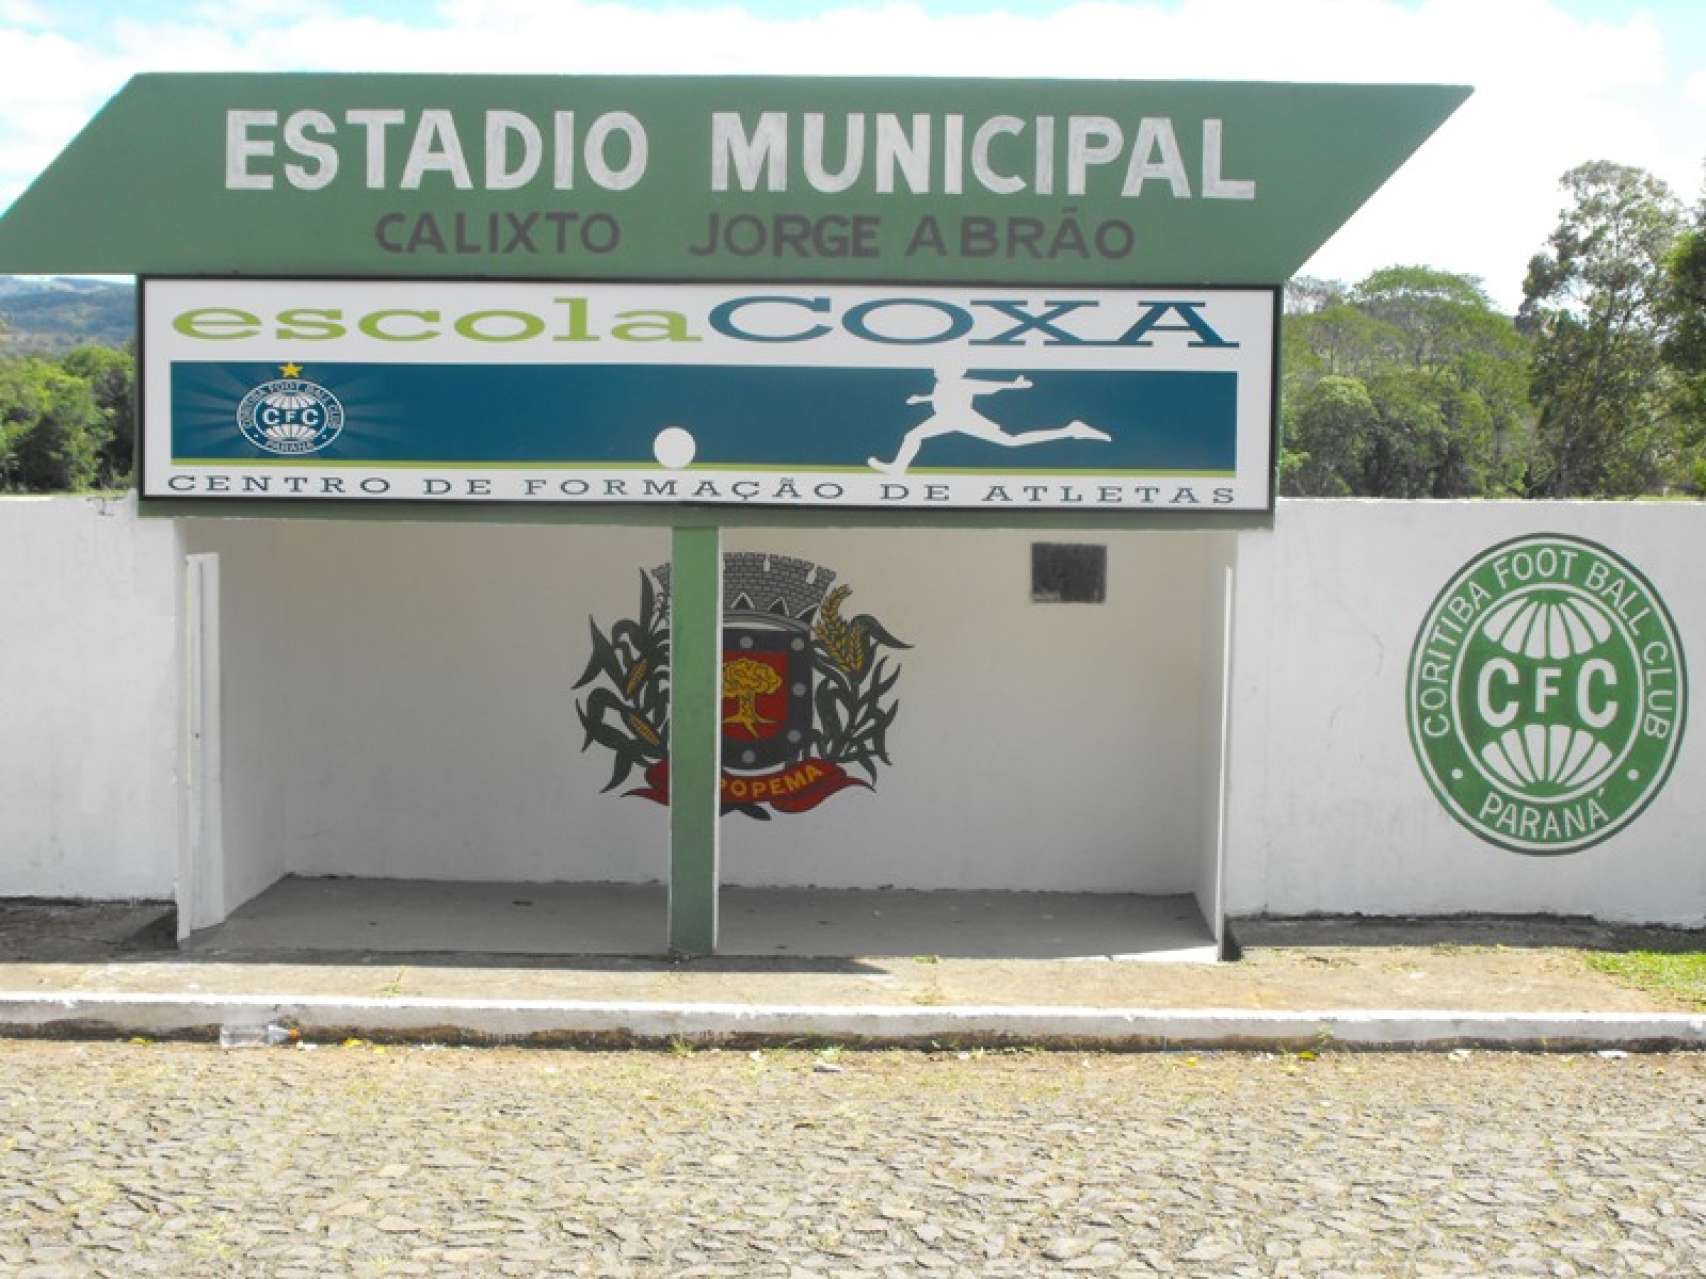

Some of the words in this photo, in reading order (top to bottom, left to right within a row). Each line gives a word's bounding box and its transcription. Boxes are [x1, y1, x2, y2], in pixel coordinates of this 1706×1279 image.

[224, 108, 649, 192] ESTADIO
[711, 111, 1256, 201] MUNICIPAL
[375, 211, 621, 254] CALIXTO
[689, 213, 881, 258] JORGE
[904, 206, 1135, 260] ABRÃO
[263, 408, 319, 425] CFC
[167, 474, 391, 494] CENTRO
[423, 478, 492, 496] DE
[524, 477, 845, 501] FORMAÇÃO
[879, 483, 951, 501] DE
[981, 485, 1236, 504] ATLETAS
[1419, 580, 1492, 739] CORITIBA
[1492, 547, 1579, 589] FOOT
[1584, 560, 1650, 636] BALL
[1643, 640, 1674, 740] CLUB
[1477, 657, 1619, 728] CFC
[1479, 787, 1610, 840] PARANÁ
